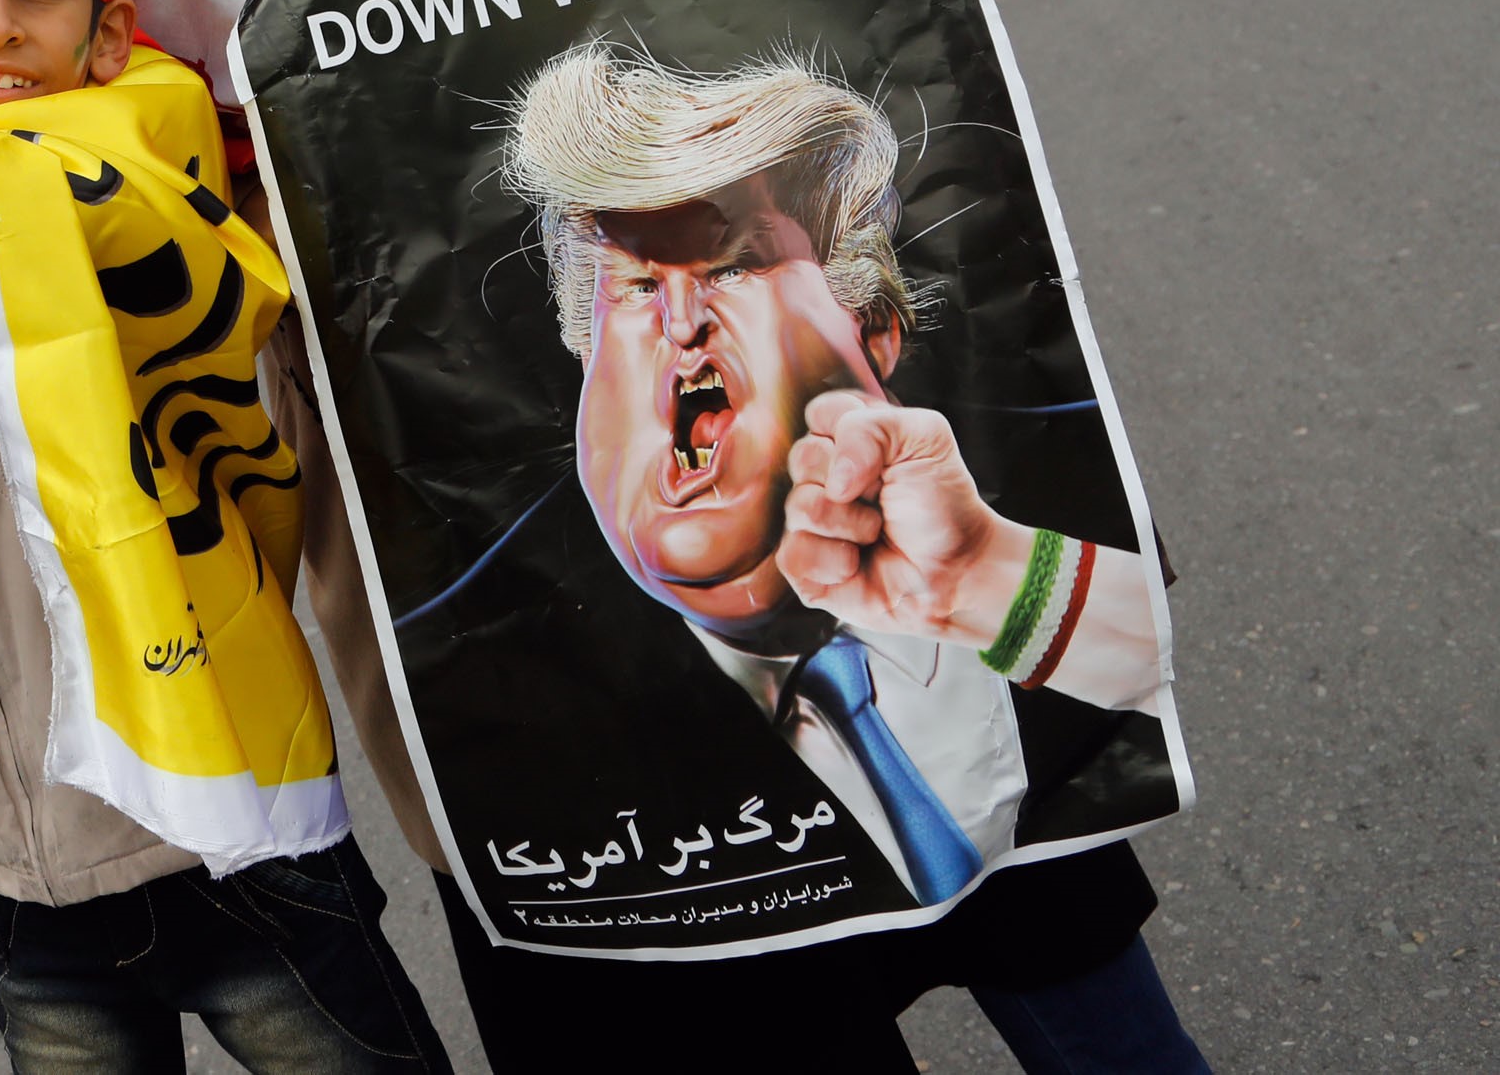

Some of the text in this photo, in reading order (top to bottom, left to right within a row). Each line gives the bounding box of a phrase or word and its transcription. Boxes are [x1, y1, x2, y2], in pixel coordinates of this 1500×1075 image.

[486, 795, 836, 892] مرگ بر آمریکا
[681, 902, 744, 925] مدیران
[749, 900, 760, 915] و
[513, 908, 529, 927] ۲
[533, 911, 613, 928] منطقه
[618, 912, 677, 927] محلات
